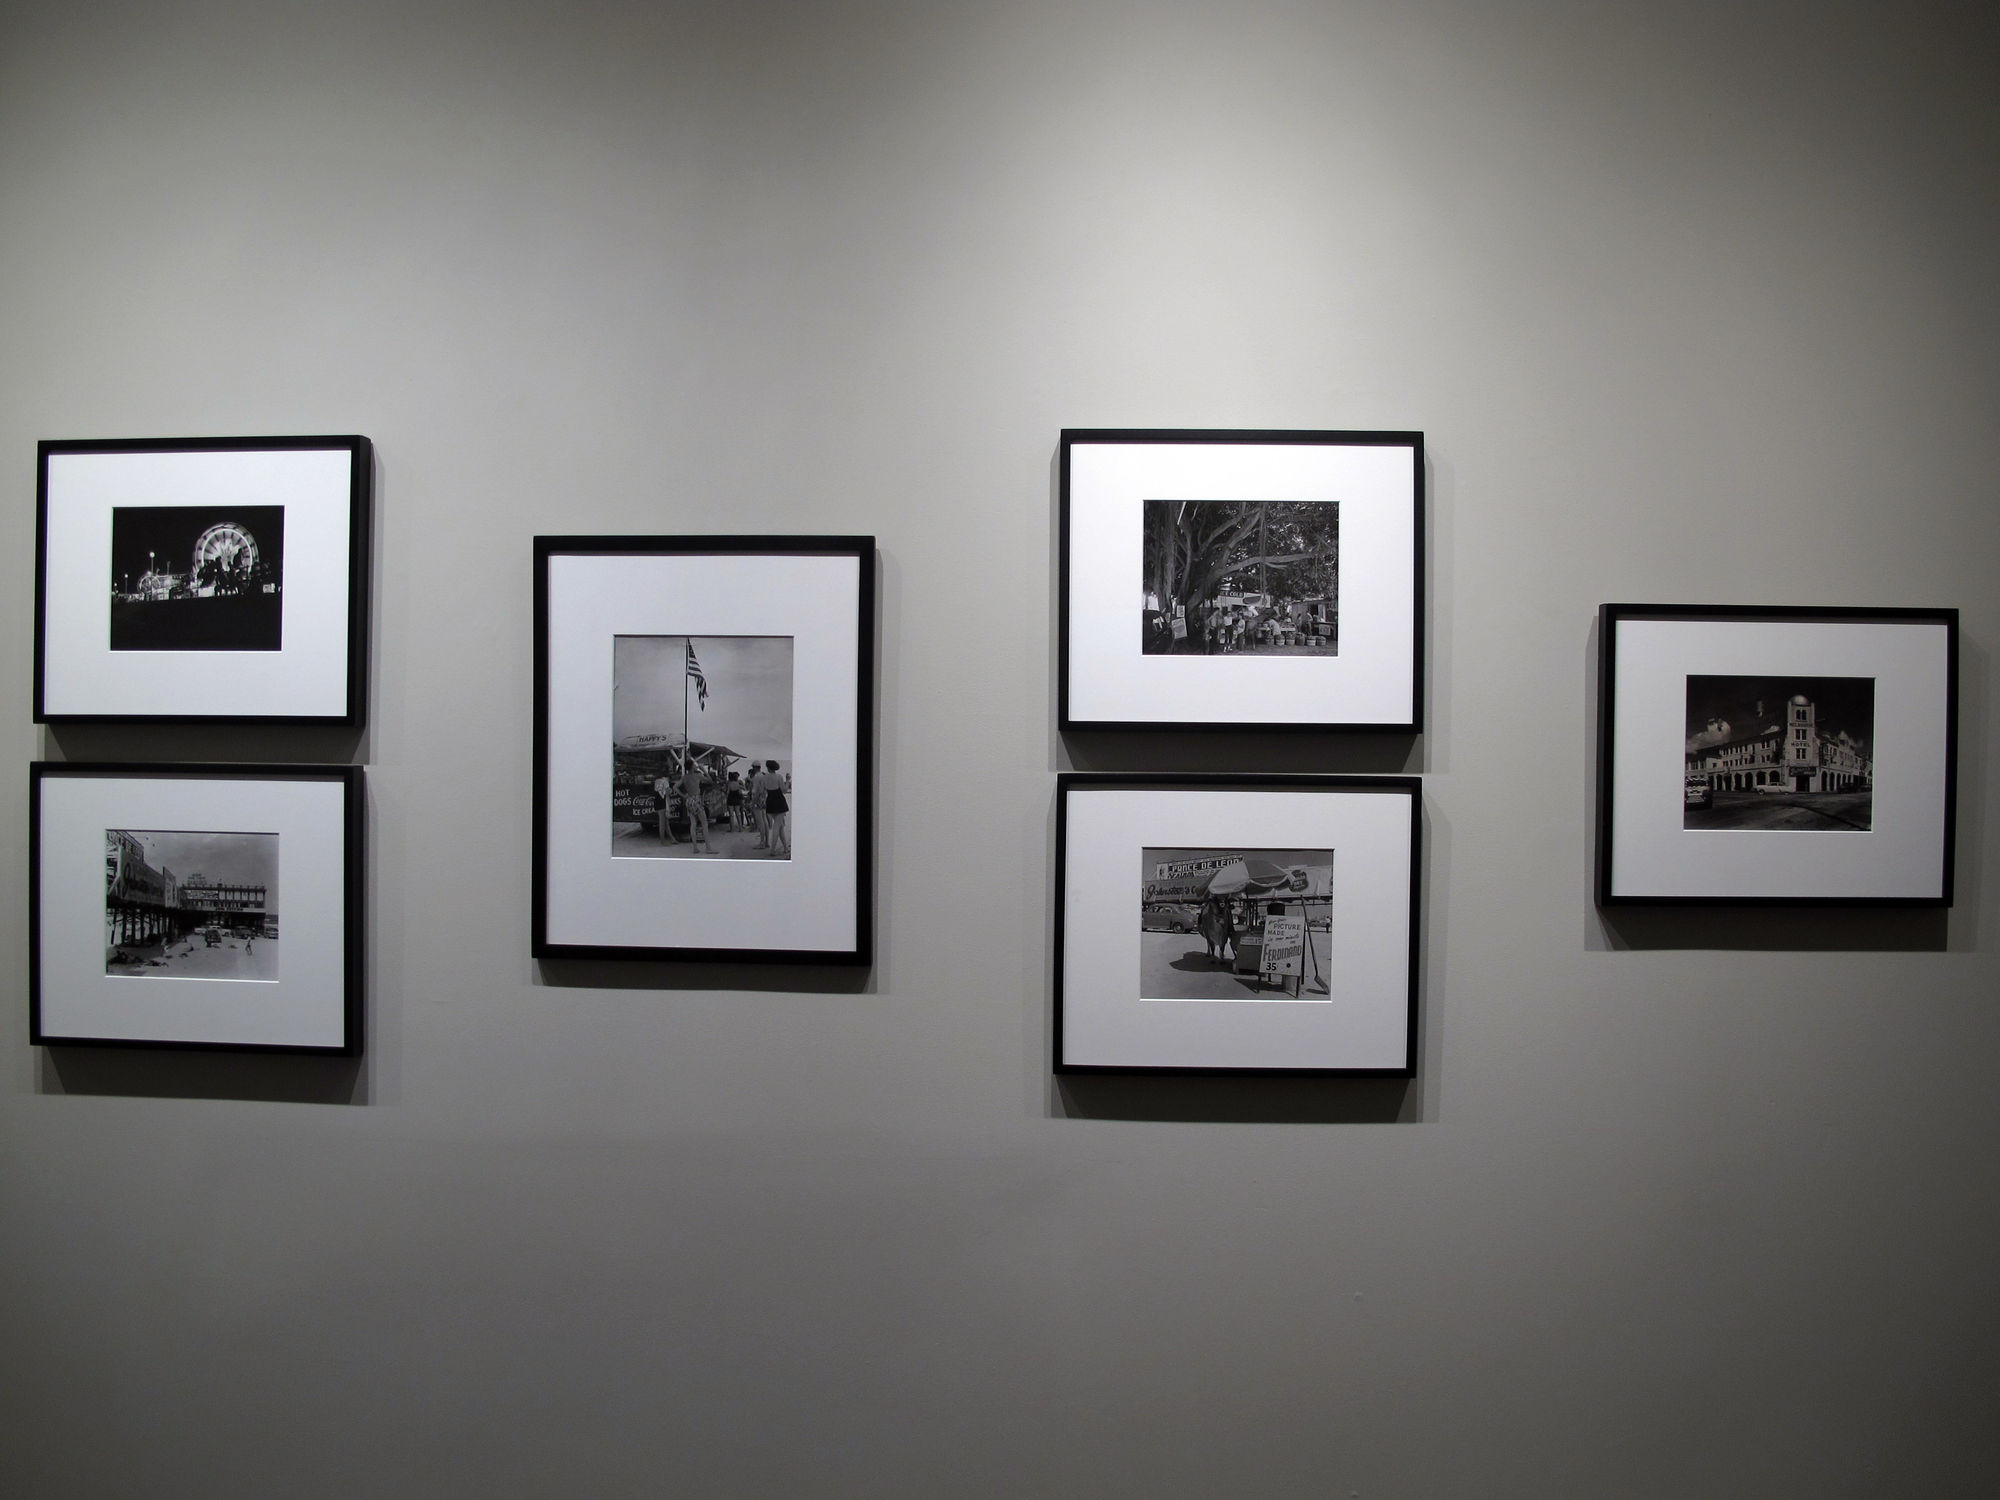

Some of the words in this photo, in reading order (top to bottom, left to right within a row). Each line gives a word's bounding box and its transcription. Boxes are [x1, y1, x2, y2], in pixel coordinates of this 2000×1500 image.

[615, 789, 630, 797] HOT
[614, 797, 632, 806] DOGS
[632, 808, 641, 816] ICE
[641, 807, 656, 815] CREA
[1172, 863, 1198, 872] PONCE
[1201, 861, 1213, 869] DE
[1273, 923, 1300, 931] PICTURE
[1263, 943, 1302, 962] FERDINAND
